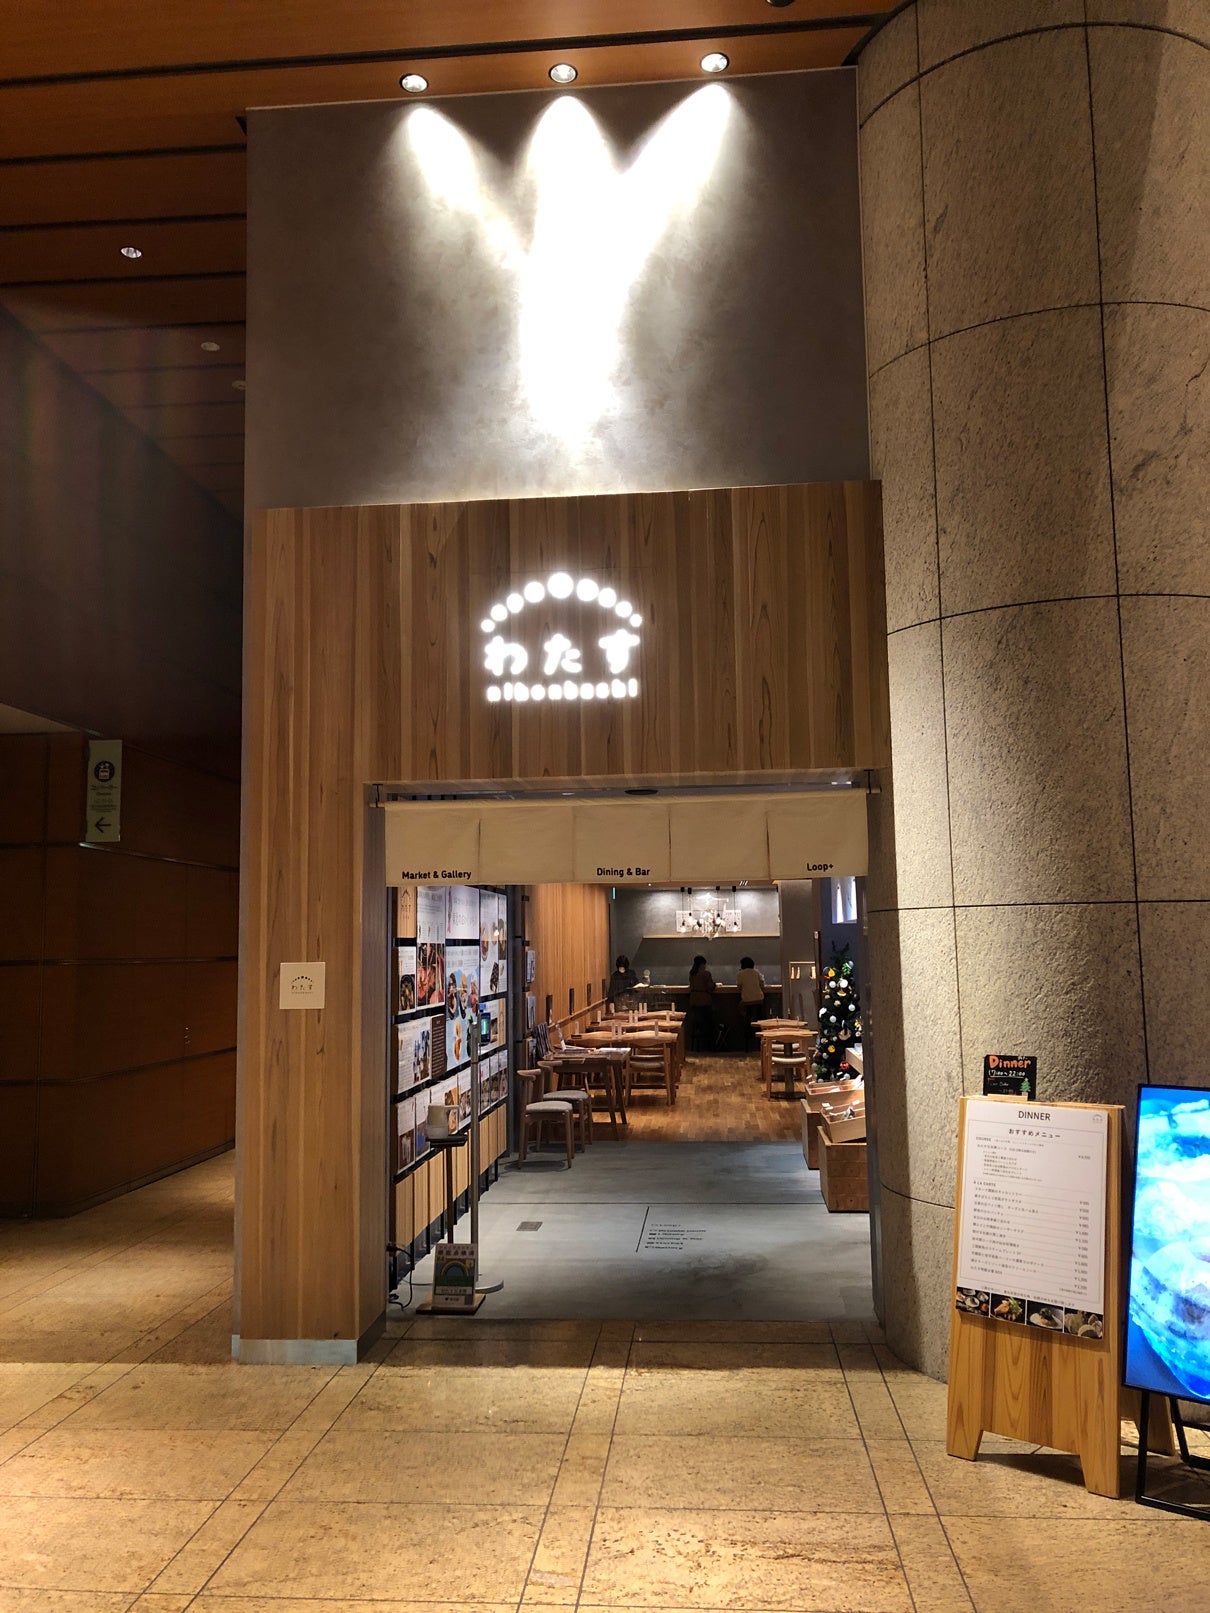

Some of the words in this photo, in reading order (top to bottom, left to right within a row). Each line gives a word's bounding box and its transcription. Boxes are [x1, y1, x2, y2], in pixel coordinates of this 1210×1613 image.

[484, 628, 641, 677] わたす
[597, 867, 624, 878] Dining
[626, 867, 633, 876] &
[635, 867, 651, 876] Bar
[806, 862, 834, 872] Loop+
[402, 871, 431, 880] Market
[433, 870, 439, 879] &
[441, 870, 472, 881] Gallery
[989, 1055, 1031, 1069] Dinner
[1018, 1110, 1051, 1121] DINNER
[1008, 1128, 1061, 1138] おすすめメニュー
